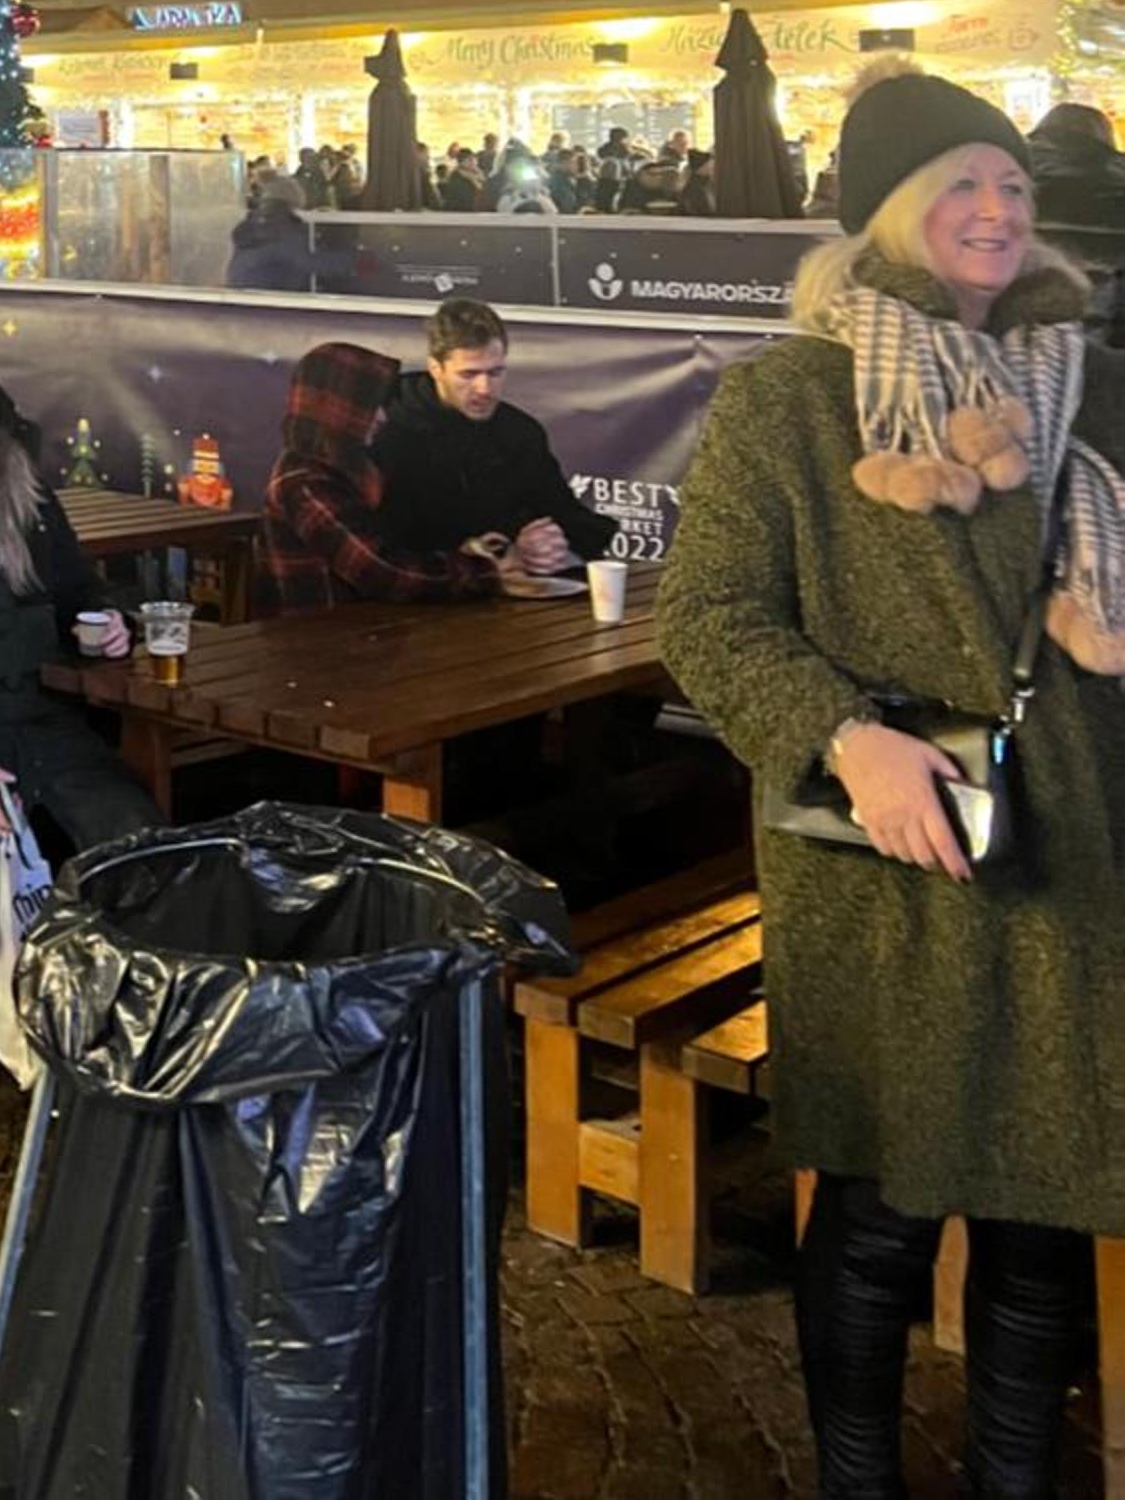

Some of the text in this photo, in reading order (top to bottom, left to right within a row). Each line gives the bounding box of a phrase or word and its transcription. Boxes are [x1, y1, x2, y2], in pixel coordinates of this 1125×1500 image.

[594, 478, 664, 508] BEST
[620, 518, 663, 536] RKET
[603, 531, 664, 562] 022
